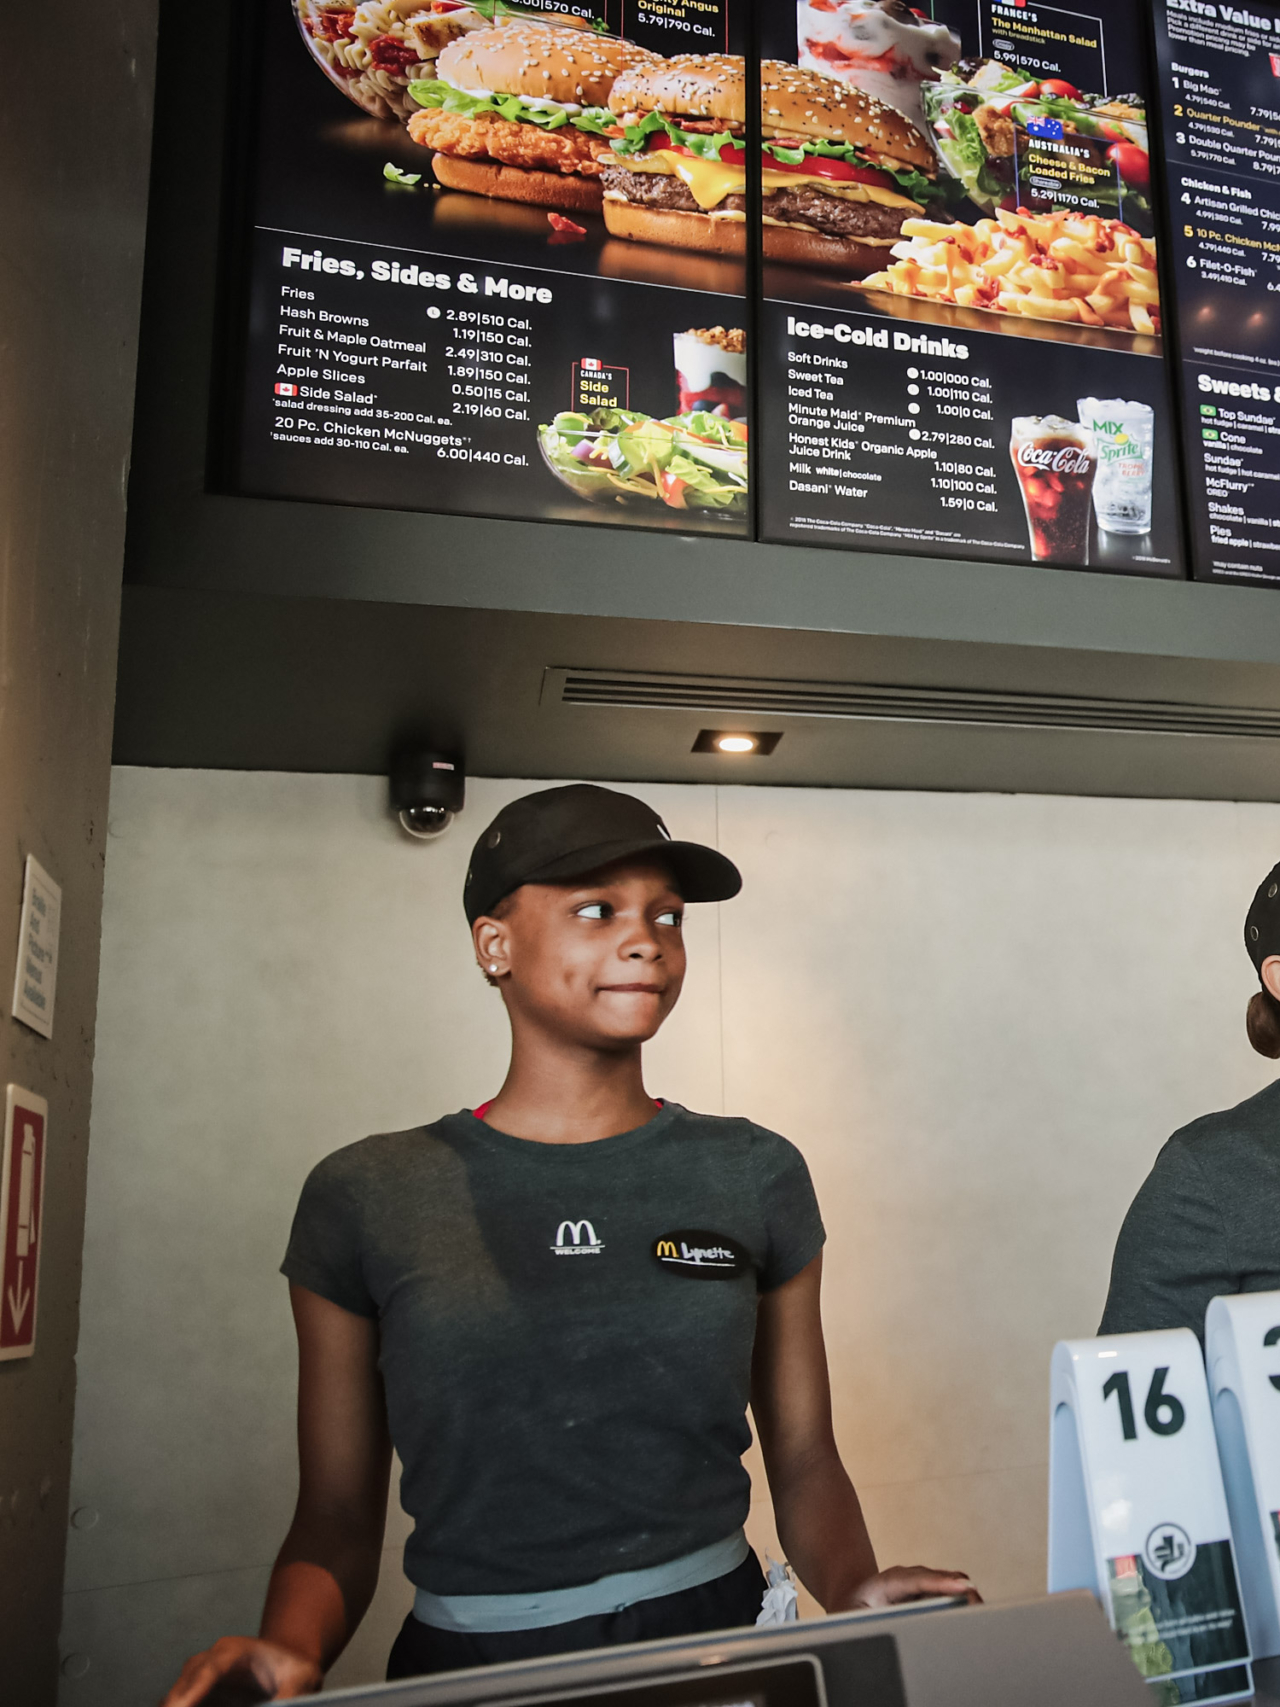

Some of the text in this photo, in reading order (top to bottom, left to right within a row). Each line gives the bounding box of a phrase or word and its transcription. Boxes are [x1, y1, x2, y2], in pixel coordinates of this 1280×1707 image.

[638, 0, 685, 18] Original
[682, 0, 719, 13] Angus
[991, 4, 1037, 22] FRANCE'S
[1166, 0, 1217, 18] Extra
[1219, 4, 1271, 31] Value
[693, 23, 715, 37] Cal.
[1167, 17, 1237, 39] Pick different drink
[1189, 13, 1214, 27] include
[1215, 21, 1243, 33] medium
[991, 17, 1097, 48] The Manhattan Salad
[992, 27, 1045, 44] with breadstick
[1168, 24, 1246, 49] Promotion pricing may
[1168, 32, 1188, 42] lower
[1189, 36, 1205, 46] than
[1206, 41, 1223, 50] meal
[1042, 61, 1061, 73] Cal.
[1171, 62, 1209, 78] Burgers
[1172, 77, 1198, 92] 1 Big
[1173, 104, 1221, 123] 2 Quarter
[1028, 139, 1090, 158] AUSTRALIA'S
[1175, 132, 1257, 158] 3 Double Quarter
[1028, 153, 1110, 177] Cheese & Bacon
[1029, 165, 1068, 179] Loaded
[1069, 172, 1095, 184] Fries
[1181, 177, 1252, 200] Chicken & Fish
[1080, 197, 1100, 208] Cal.
[1181, 192, 1191, 204] 4
[1194, 196, 1228, 210] Artisan
[1229, 203, 1258, 217] Grilled
[1184, 225, 1262, 249] 5 10 Pc. Chicken
[1186, 256, 1196, 269] 6
[282, 246, 552, 304] Fries, Sides & More
[281, 286, 315, 300] Fries
[280, 305, 369, 327] Hash Browns
[507, 316, 532, 330] Cal.
[279, 324, 426, 353] Fruit & Maple Oatmeal
[787, 317, 969, 360] Ice-Cold Drinks
[278, 344, 311, 358] Fruit
[333, 353, 378, 369] Yogurt
[382, 357, 427, 372] Parfait
[788, 352, 848, 369] Soft Drinks
[276, 364, 365, 384] Apple Slices
[580, 370, 612, 380] CANADA'S
[788, 369, 844, 386] Sweet Tea
[300, 386, 330, 400] Side
[580, 380, 609, 393] Side
[788, 386, 833, 401] Iced Tea
[1198, 374, 1271, 401] Sweets
[580, 394, 617, 408] Salad
[972, 392, 993, 404] Cal.
[306, 402, 351, 415] dressing
[354, 408, 373, 417] add
[376, 409, 414, 422] 35-200
[416, 414, 435, 424] Cal.
[437, 417, 452, 425] ea.
[789, 403, 916, 428] Minute Premium
[1218, 408, 1235, 421] Top
[275, 417, 380, 438] 20 Pc. Chicken
[788, 414, 865, 433] Orange Juice
[1093, 419, 1124, 435] MIX
[789, 433, 937, 459] Honest Organic Apple
[1220, 432, 1246, 444] Cone
[789, 445, 851, 460] Juice Drink
[1018, 442, 1090, 474] Coca-Cola
[1100, 441, 1138, 461] Sprite
[790, 462, 811, 474] Milk
[835, 485, 868, 498] Water
[1208, 502, 1244, 515] Shakes
[1210, 525, 1232, 537] Pies
[1103, 1366, 1186, 1441] 16
